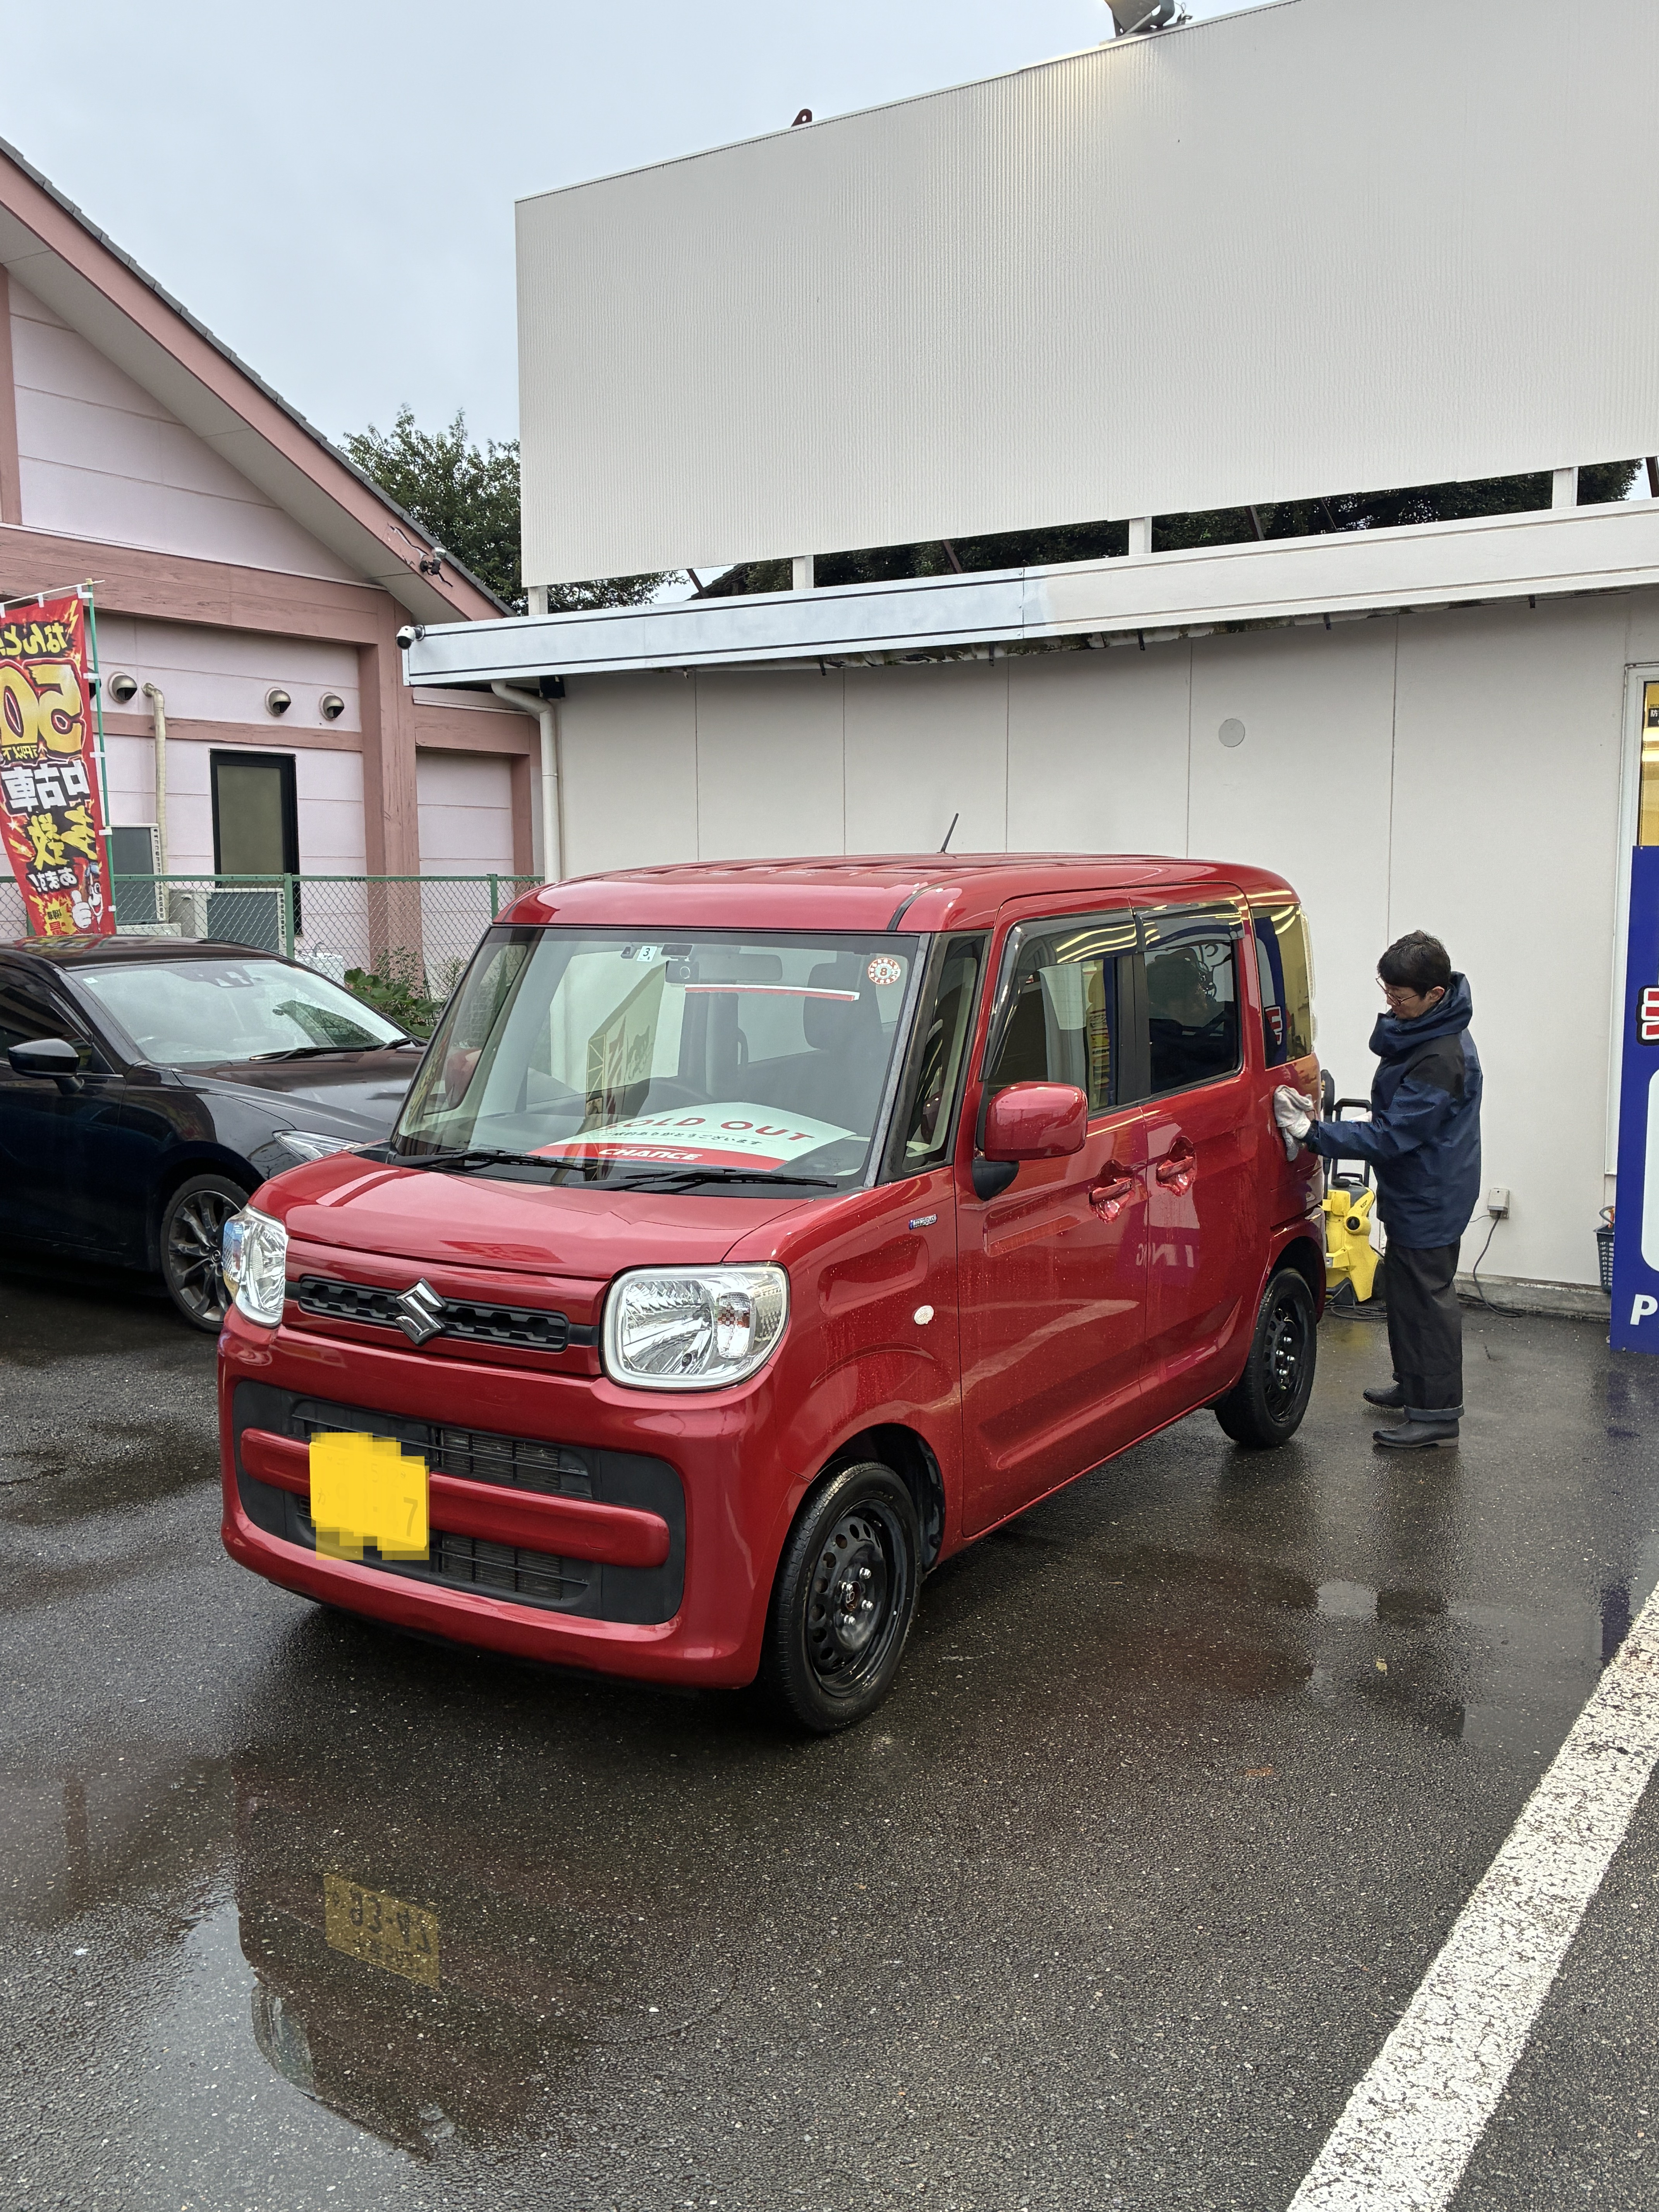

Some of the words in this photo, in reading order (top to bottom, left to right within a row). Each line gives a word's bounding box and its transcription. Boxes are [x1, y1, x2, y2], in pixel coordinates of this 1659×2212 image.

[880, 967, 888, 976] 8
[721, 1121, 815, 1141] OUT
[599, 1149, 703, 1160] CHANCE
[1630, 1294, 1659, 1326] P
